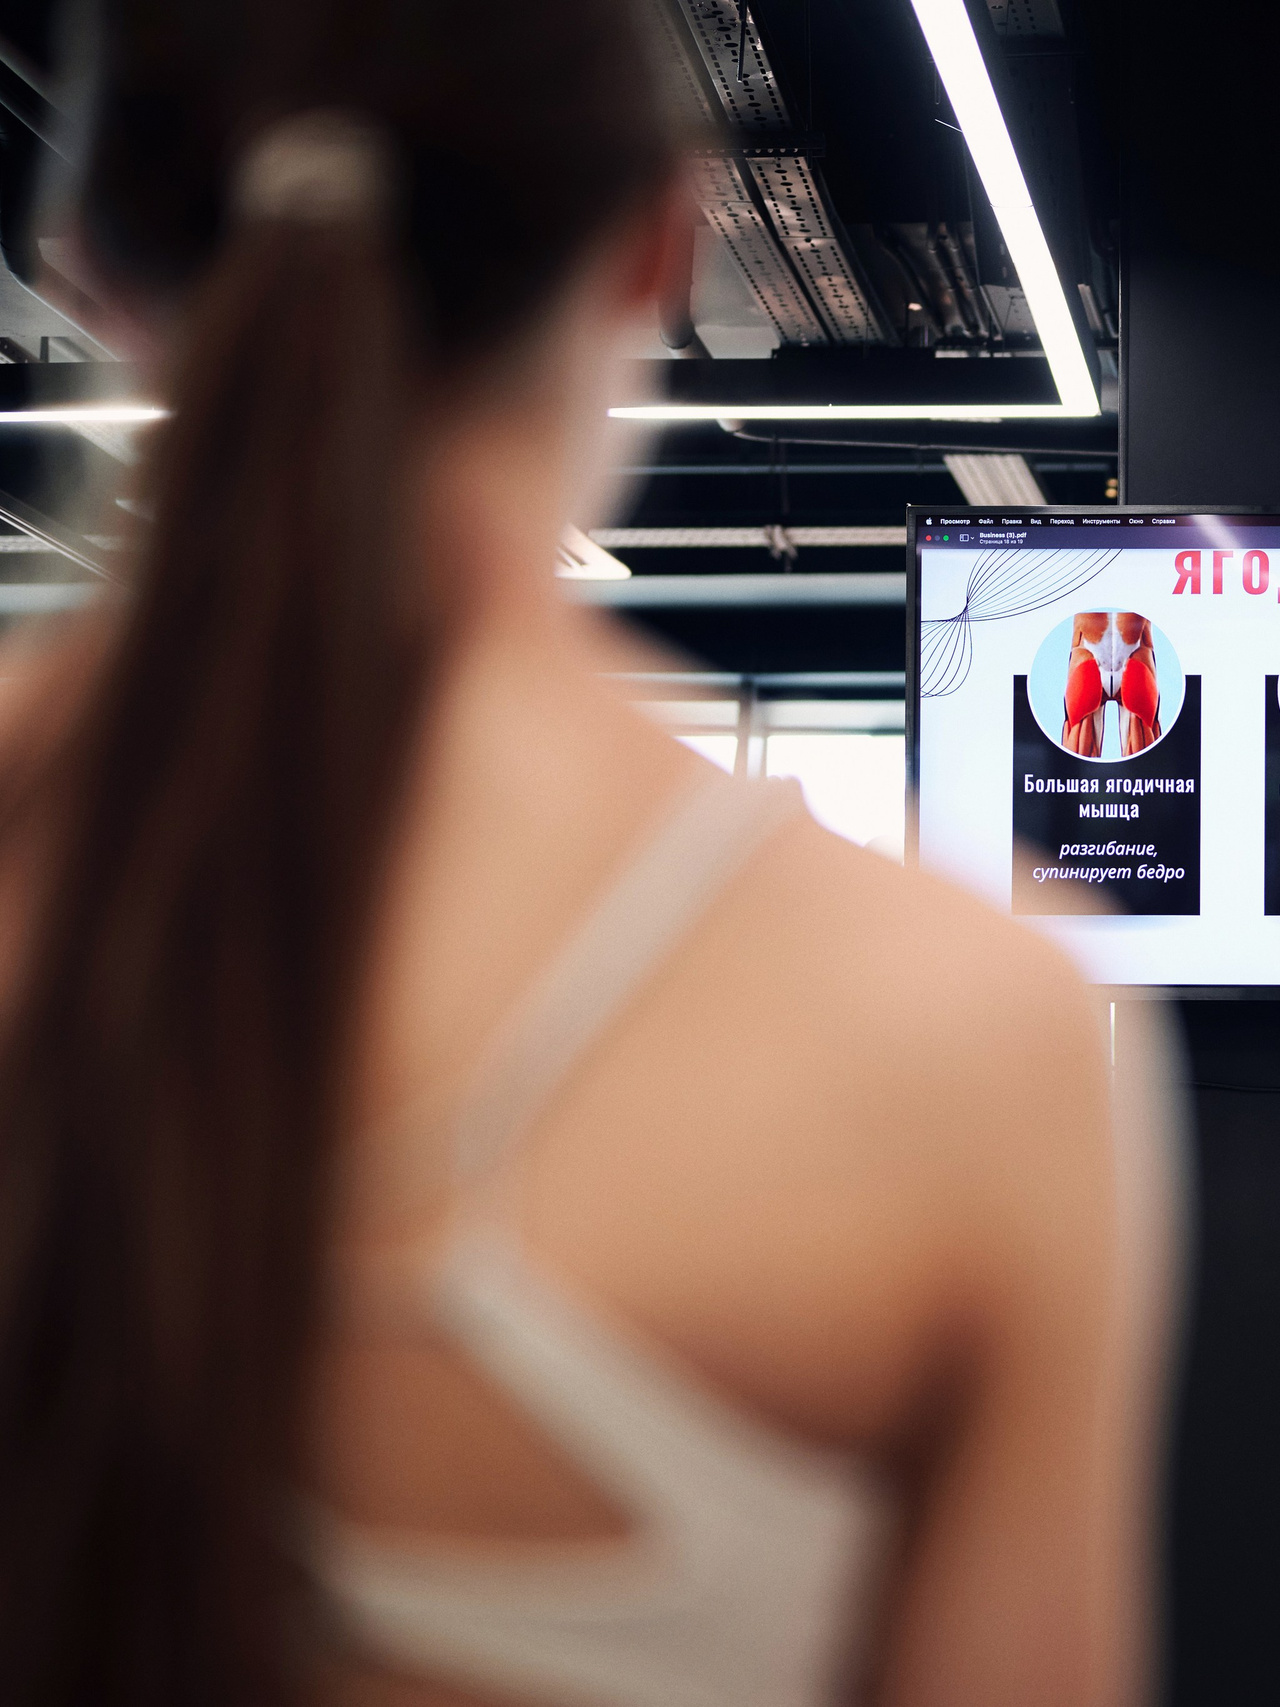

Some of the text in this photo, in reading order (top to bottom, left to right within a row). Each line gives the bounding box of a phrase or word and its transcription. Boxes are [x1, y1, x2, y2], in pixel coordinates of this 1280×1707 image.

[1024, 773, 1195, 796] Большая ягодичная
[1079, 803, 1140, 821] мышца
[1059, 840, 1158, 860] разгибание,
[1032, 864, 1185, 883] супинирует бедро
